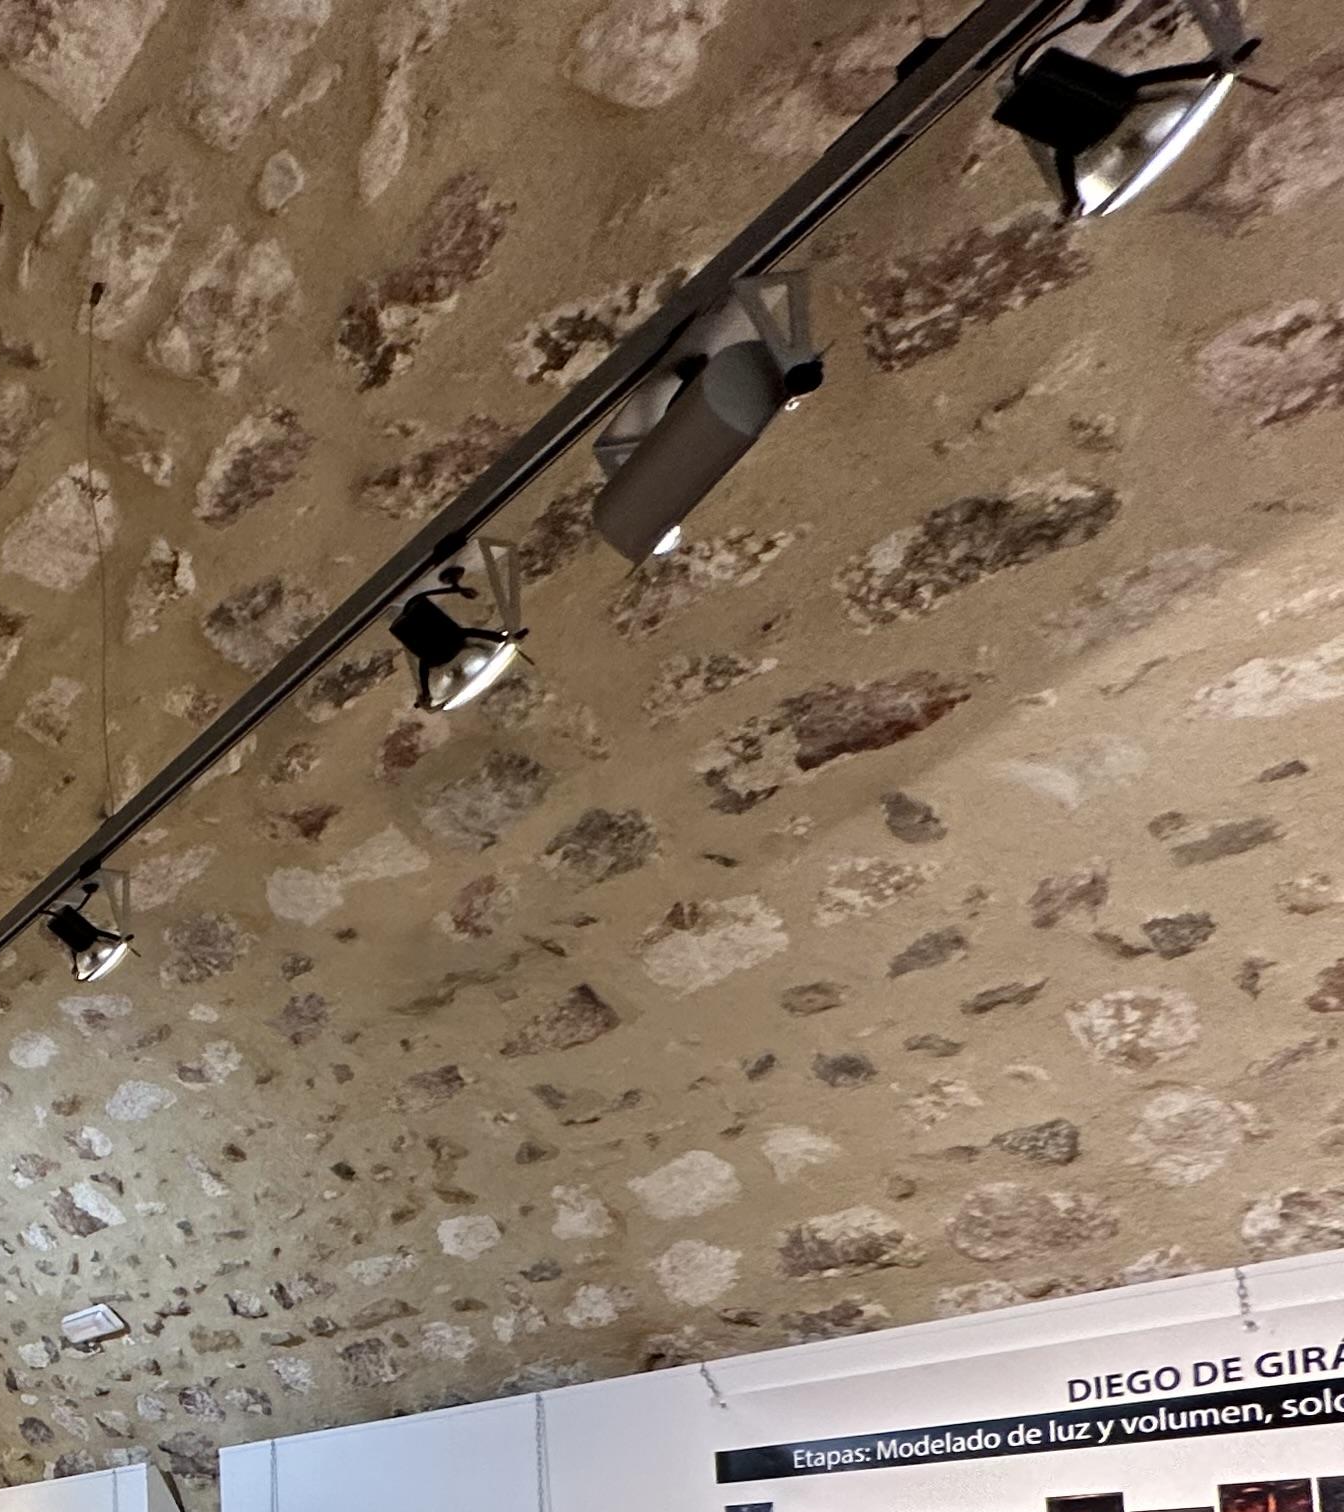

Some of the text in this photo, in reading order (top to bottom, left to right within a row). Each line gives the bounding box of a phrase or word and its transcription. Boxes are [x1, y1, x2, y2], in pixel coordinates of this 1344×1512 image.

[1067, 1366, 1182, 1403] DIEGO
[1192, 1356, 1244, 1388] DE
[793, 1447, 871, 1470] Etapas:
[876, 1428, 1001, 1461] Modelado
[1007, 1424, 1042, 1447] de
[1049, 1420, 1091, 1443] luz
[1096, 1419, 1115, 1444] y
[1120, 1402, 1274, 1435] volumen,
